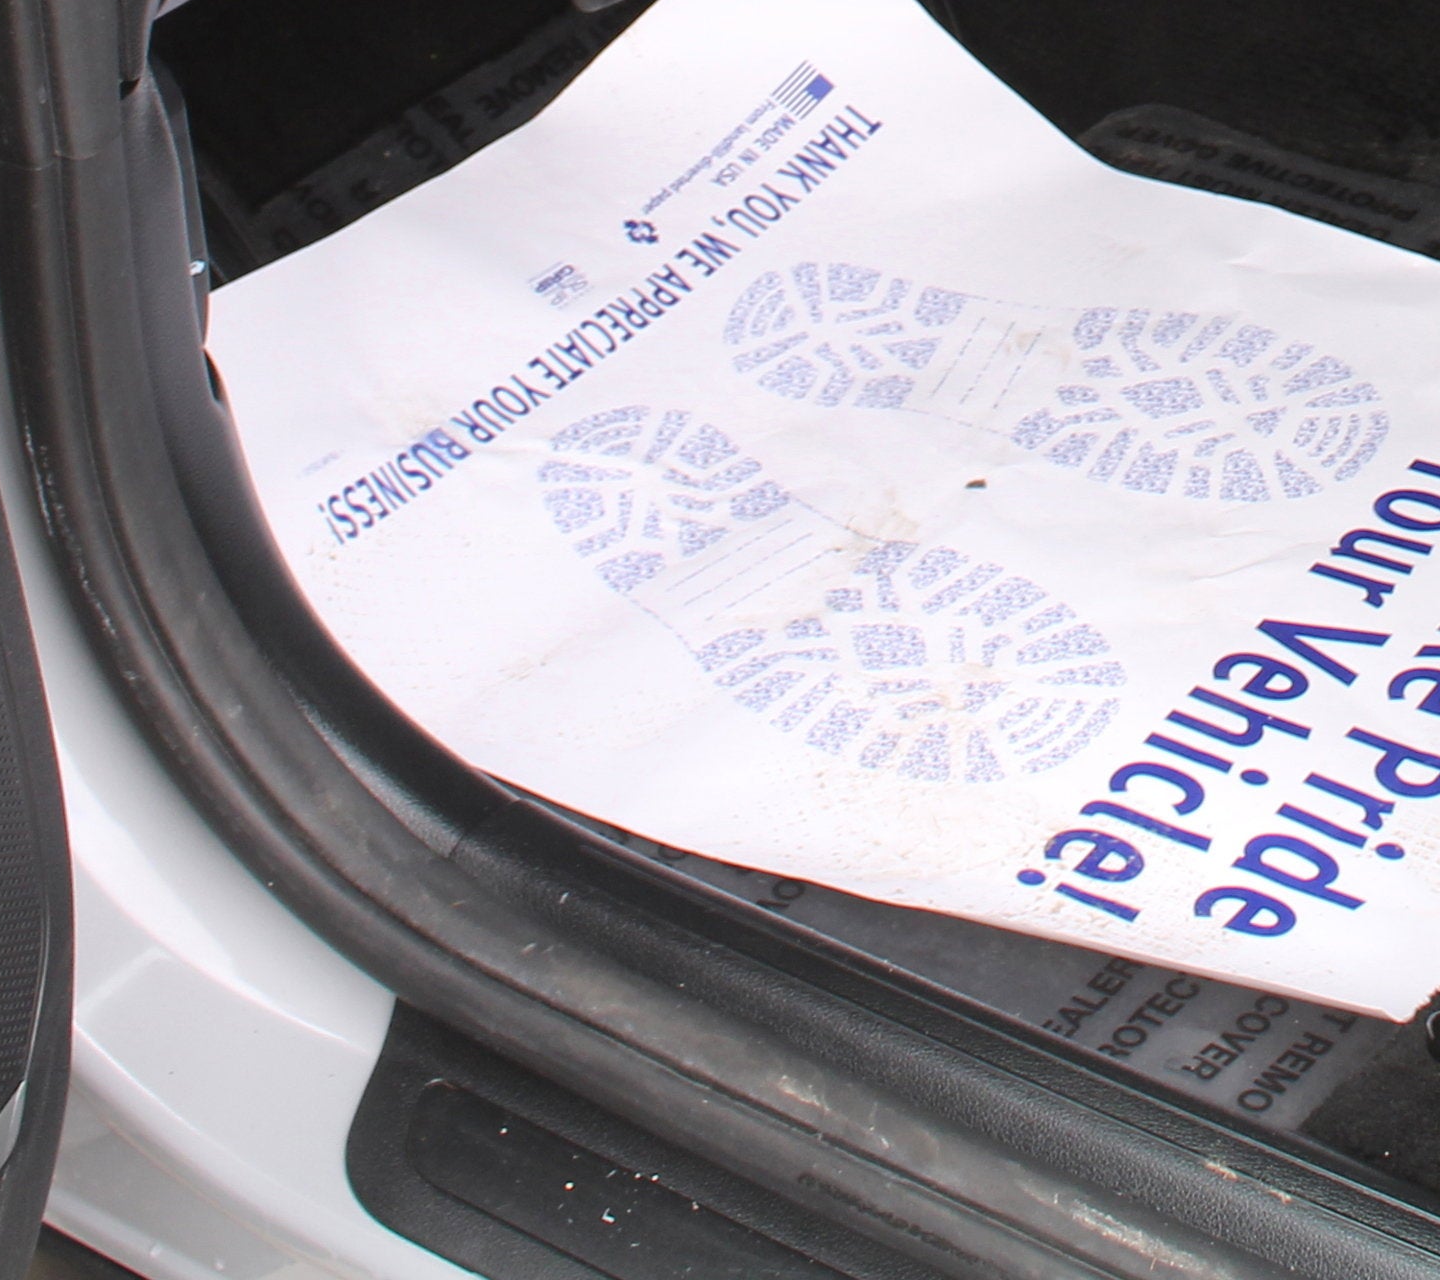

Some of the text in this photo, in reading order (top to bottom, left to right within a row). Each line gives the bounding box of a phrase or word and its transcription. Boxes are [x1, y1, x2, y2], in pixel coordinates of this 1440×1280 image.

[711, 113, 796, 187] MADE IN USA
[317, 105, 883, 545] THANK YOU, WE APPRECIATE YOUR BUSINESS!
[1016, 618, 1394, 924] Vehicle!
[1041, 956, 1143, 1038] EALER
[1181, 994, 1290, 1081] COVER
[1236, 1030, 1335, 1113] REMO
